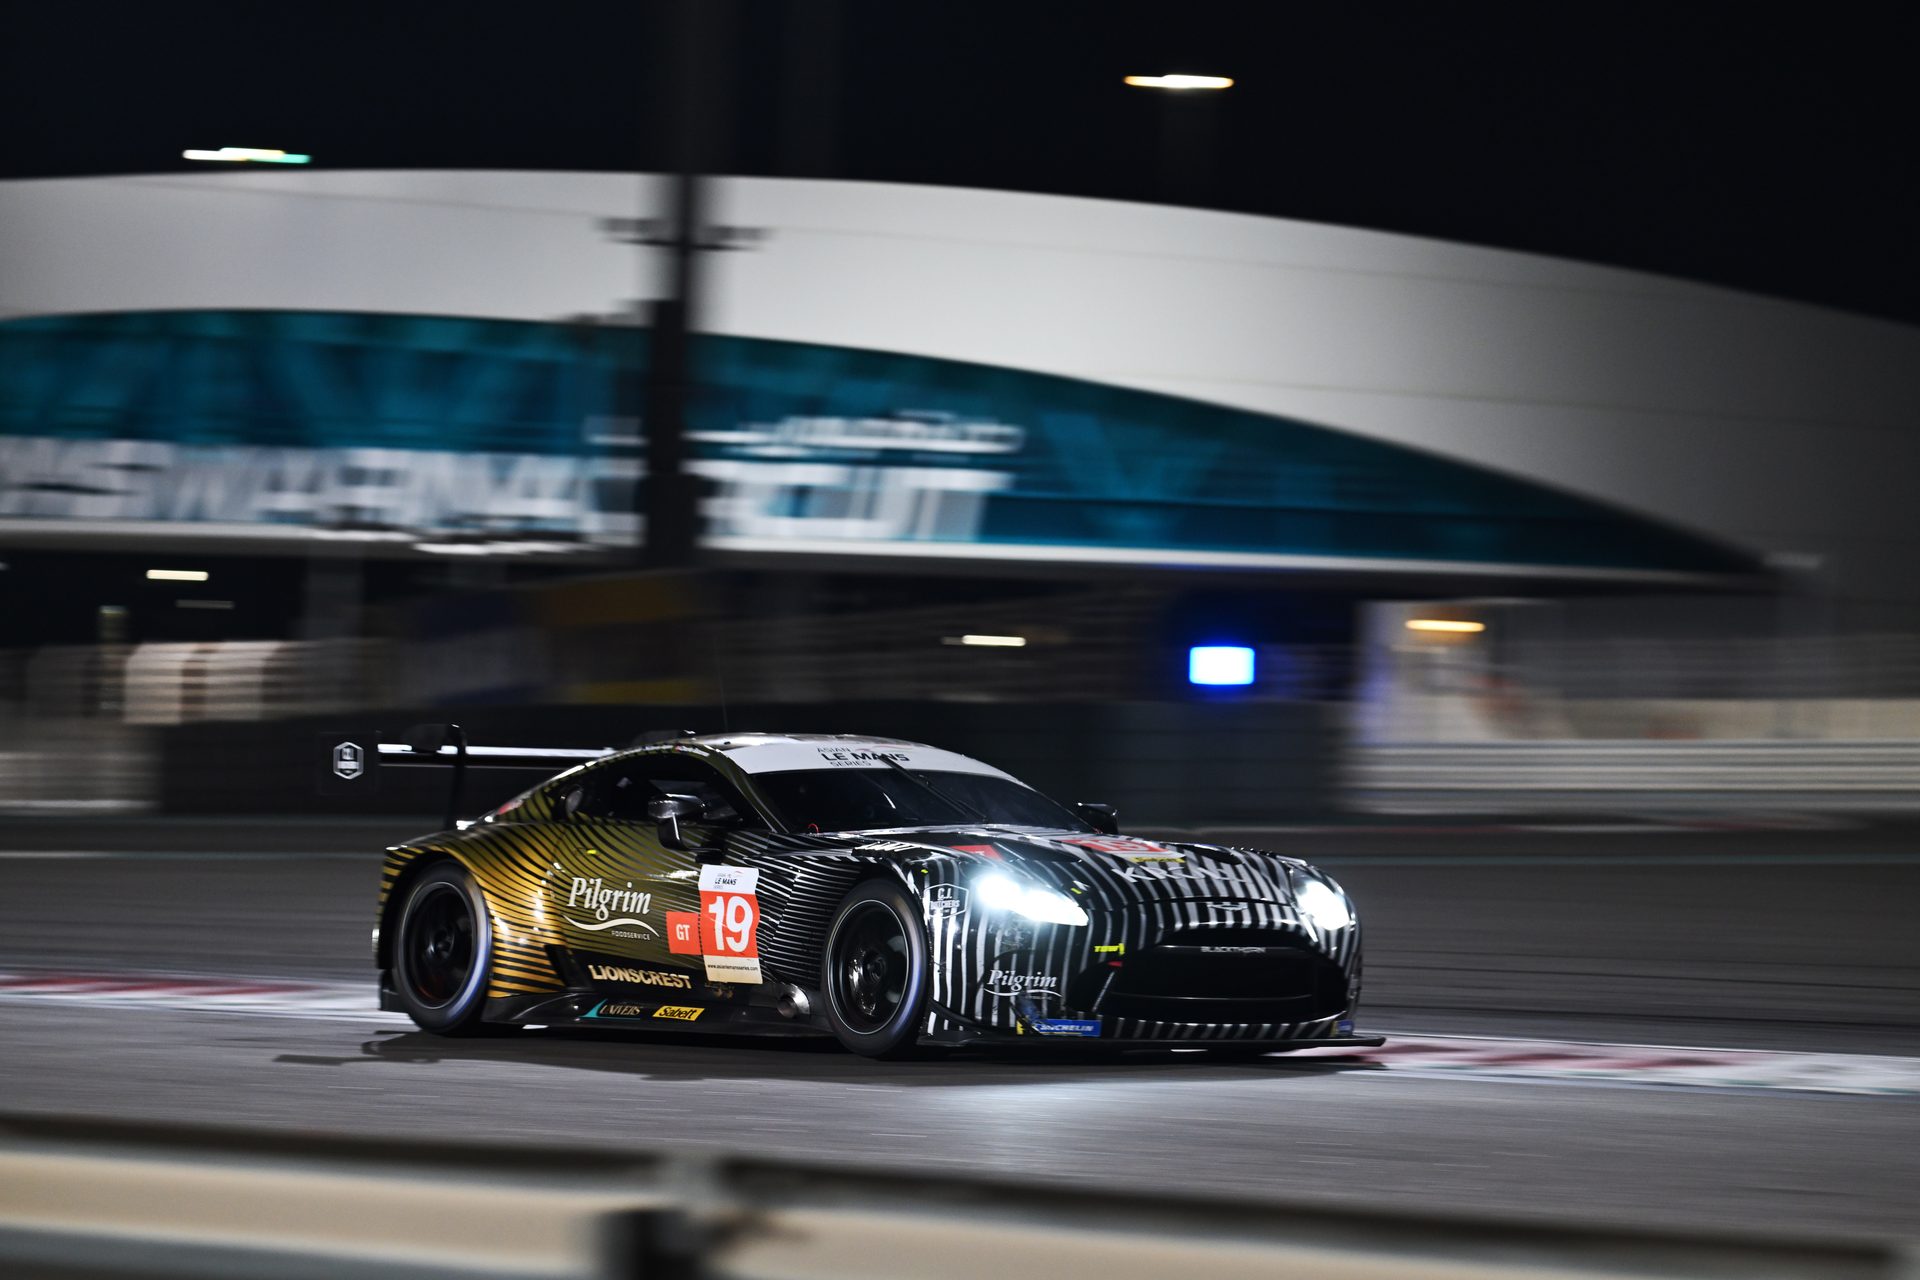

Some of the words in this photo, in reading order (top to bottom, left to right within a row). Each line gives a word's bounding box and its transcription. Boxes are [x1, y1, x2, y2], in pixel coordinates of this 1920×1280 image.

[821, 752, 848, 761] LE
[850, 752, 910, 762] MANS
[566, 876, 652, 921] Pilgrim
[675, 923, 691, 941] GT
[708, 895, 754, 953] 19
[587, 964, 693, 989] LIONSCREST
[986, 969, 1058, 992] Pilgrim
[658, 1006, 698, 1019] Sabelt
